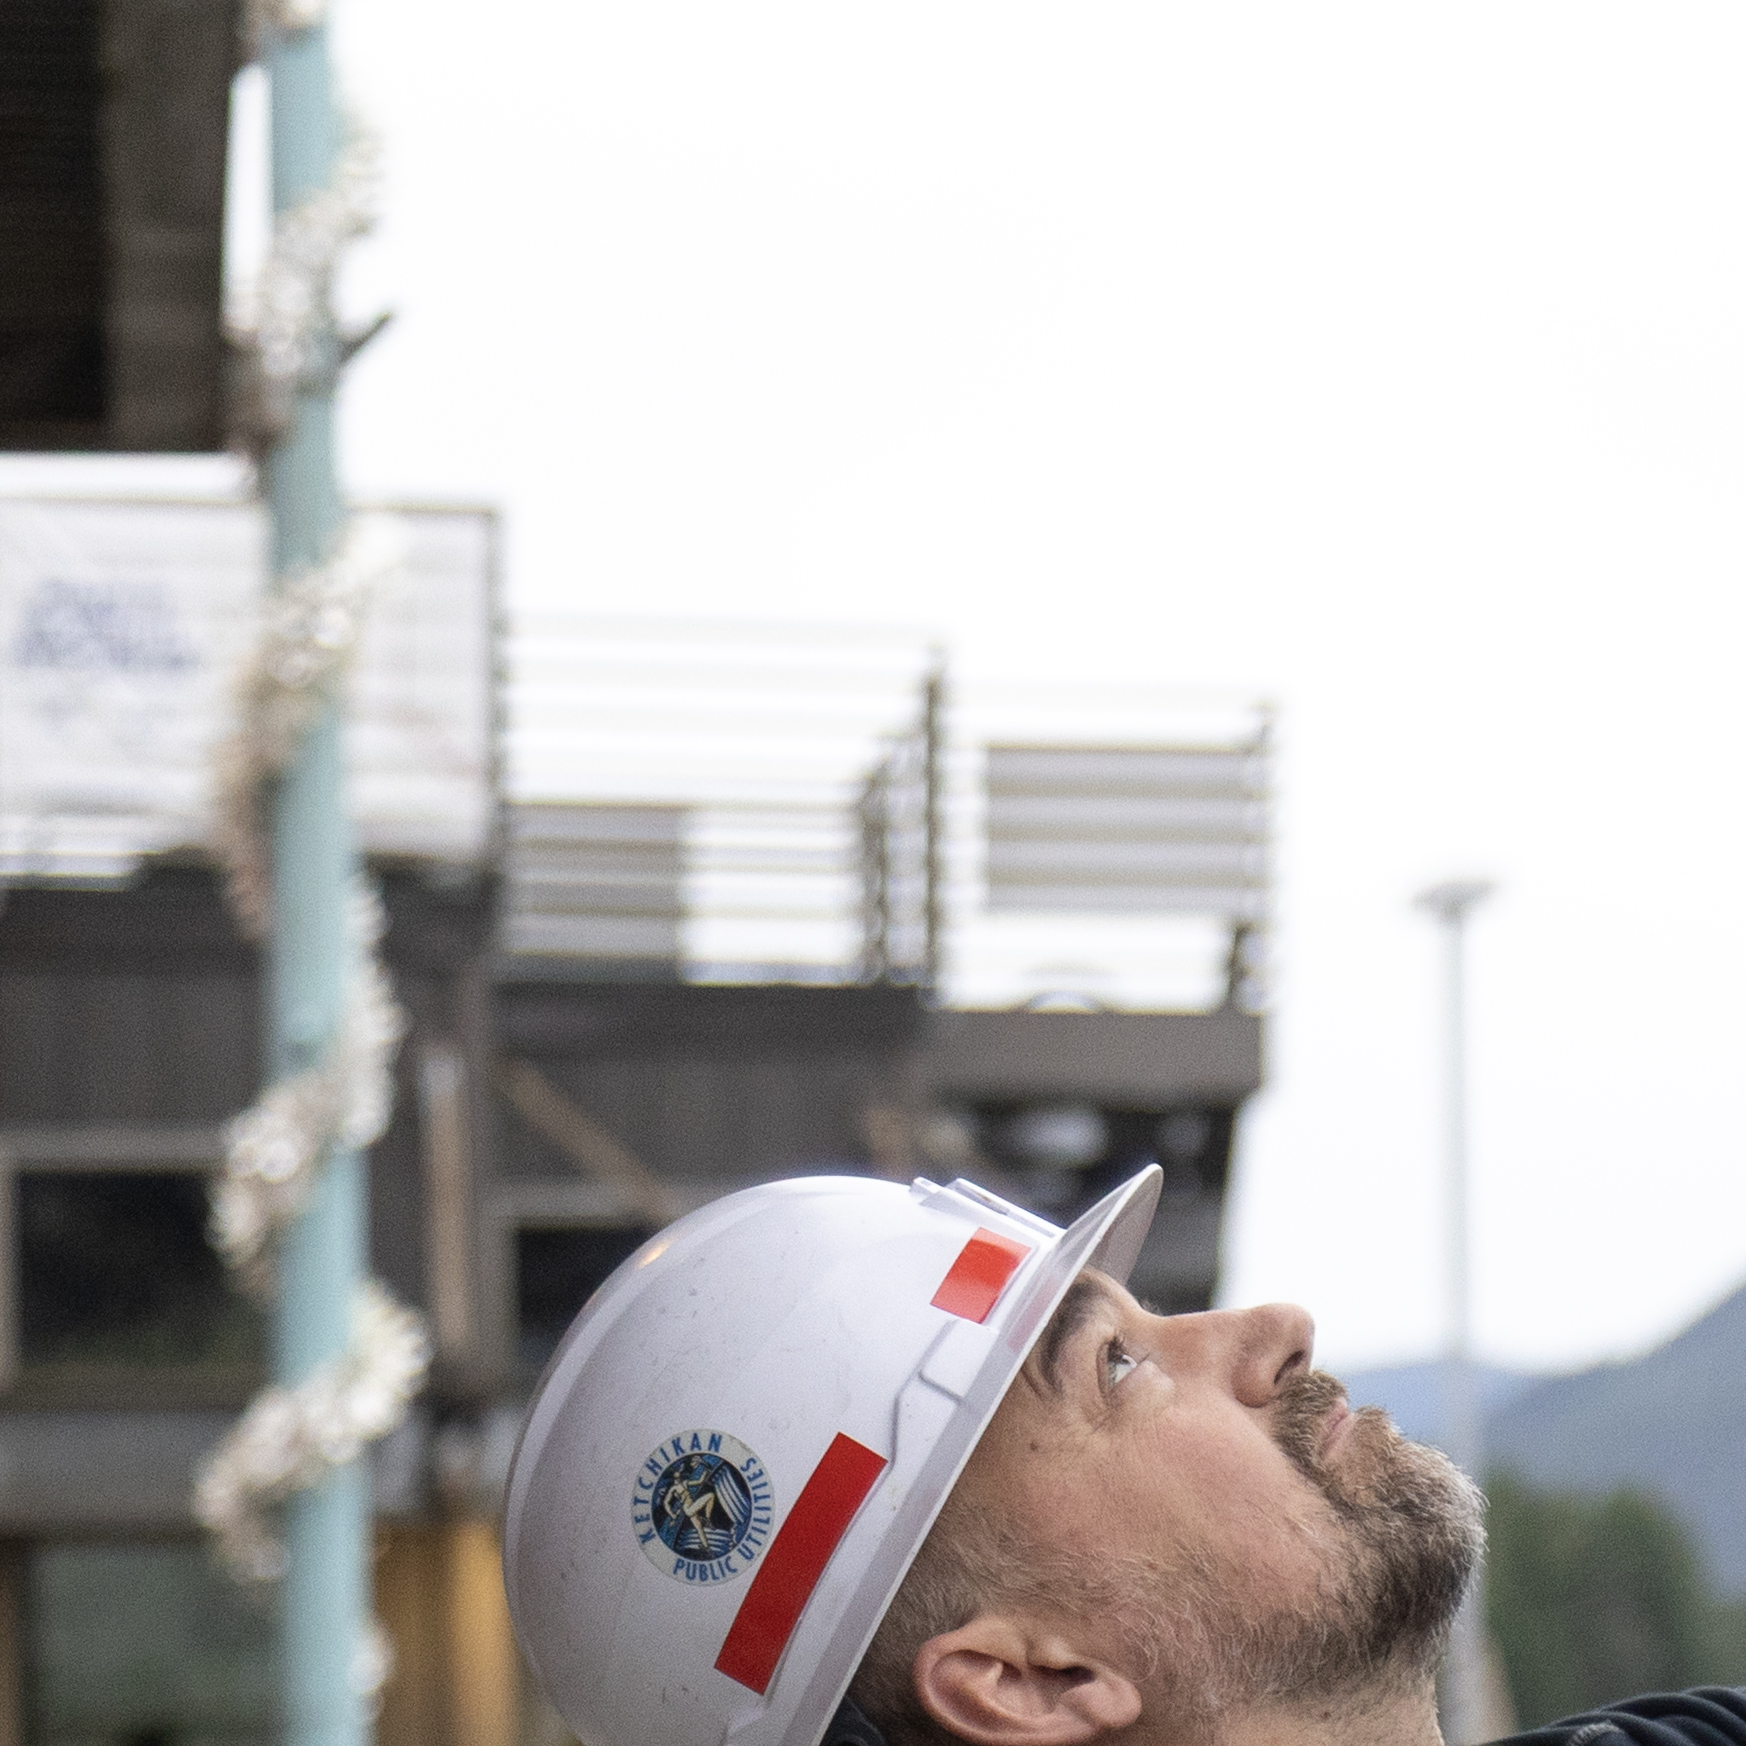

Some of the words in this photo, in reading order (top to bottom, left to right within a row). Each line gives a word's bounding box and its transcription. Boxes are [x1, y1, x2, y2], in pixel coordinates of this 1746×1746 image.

[633, 1432, 723, 1545] KETCHIKAN
[673, 1556, 739, 1582] PUBLIC
[737, 1456, 771, 1561] UTILITIES
